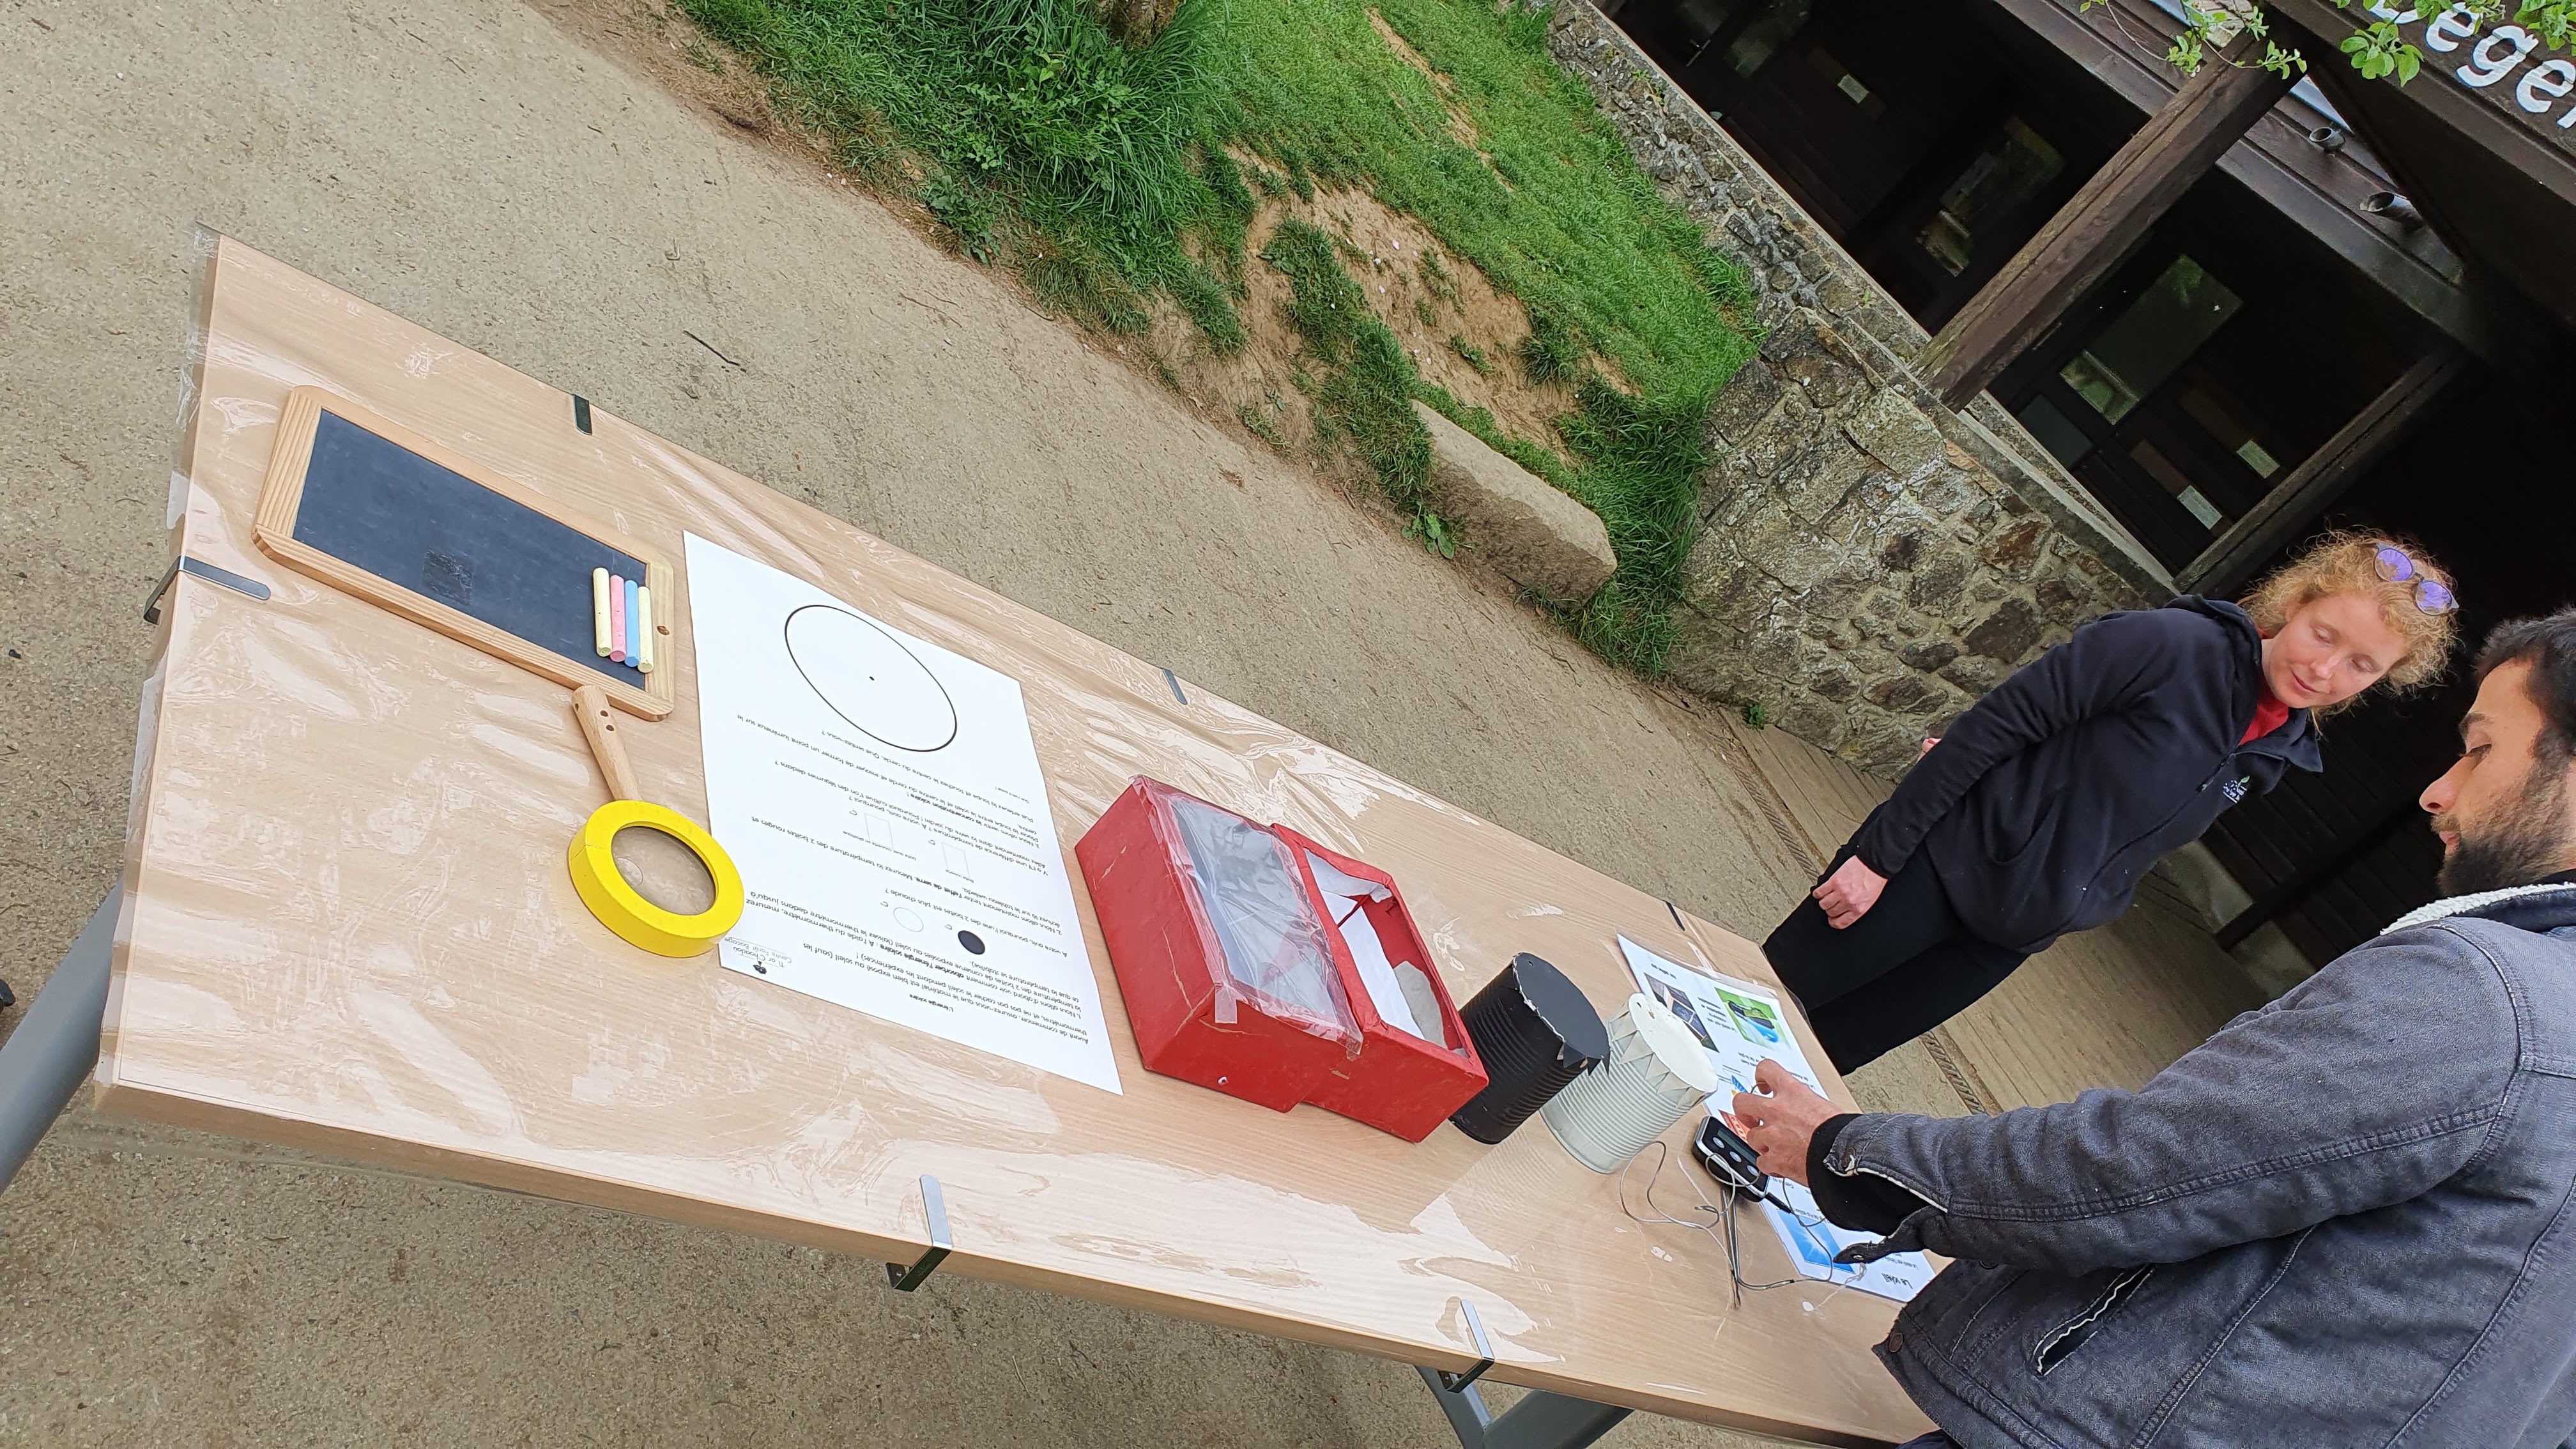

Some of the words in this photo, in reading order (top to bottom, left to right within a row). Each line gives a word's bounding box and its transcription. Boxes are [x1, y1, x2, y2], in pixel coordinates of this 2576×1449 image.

[2369, 0, 2576, 128] ege
[760, 820, 785, 832] rouges
[816, 841, 829, 849] des
[830, 846, 875, 866] température
[884, 866, 913, 881] Mesurez
[750, 891, 779, 905] jusqu'à
[891, 889, 916, 903] chaude
[944, 887, 963, 899] l'effet
[746, 899, 779, 912] mesurez
[917, 899, 931, 908] plus
[963, 895, 981, 906] tester
[780, 901, 808, 915] dedans
[982, 901, 1020, 919] maintenant
[781, 908, 834, 932] thermomètre,
[810, 911, 859, 933] thermomètre
[970, 918, 981, 926] des
[982, 923, 999, 933] l'une
[1039, 923, 1055, 933] Nous
[847, 932, 867, 945] l'aide
[868, 932, 893, 946] (laissez
[999, 929, 1029, 943] pourquoi
[803, 943, 813, 952] les
[880, 944, 903, 956] solaire
[895, 941, 912, 951] soleil
[814, 947, 833, 959] (sauf
[835, 954, 853, 964] soleil
[861, 953, 904, 974] expériences)
[903, 953, 933, 969] l'énergie
[866, 965, 891, 977] exposé
[905, 970, 915, 979] les
[934, 964, 964, 979] absorber
[954, 963, 983, 977] conserve
[893, 974, 908, 985] bien
[916, 974, 946, 988] pendant
[965, 975, 998, 990] comment
[1008, 974, 1050, 993] température
[921, 984, 951, 997] matériel
[947, 985, 965, 994] soleil
[1021, 986, 1032, 995] des
[1058, 992, 1071, 1000] que
[953, 993, 960, 1002] le
[960, 996, 974, 1005] que
[974, 993, 996, 1004] cacher
[1013, 992, 1039, 1004] d'abord
[1033, 990, 1074, 1009] température
[975, 1001, 1018, 1019] assurez-vous
[1039, 1000, 1059, 1011] allons
[1059, 1007, 1076, 1018] Nous
[1018, 1015, 1058, 1033] commencer,
[1041, 1015, 1087, 1036] thermomètres,
[1069, 1032, 1089, 1045] Avant
